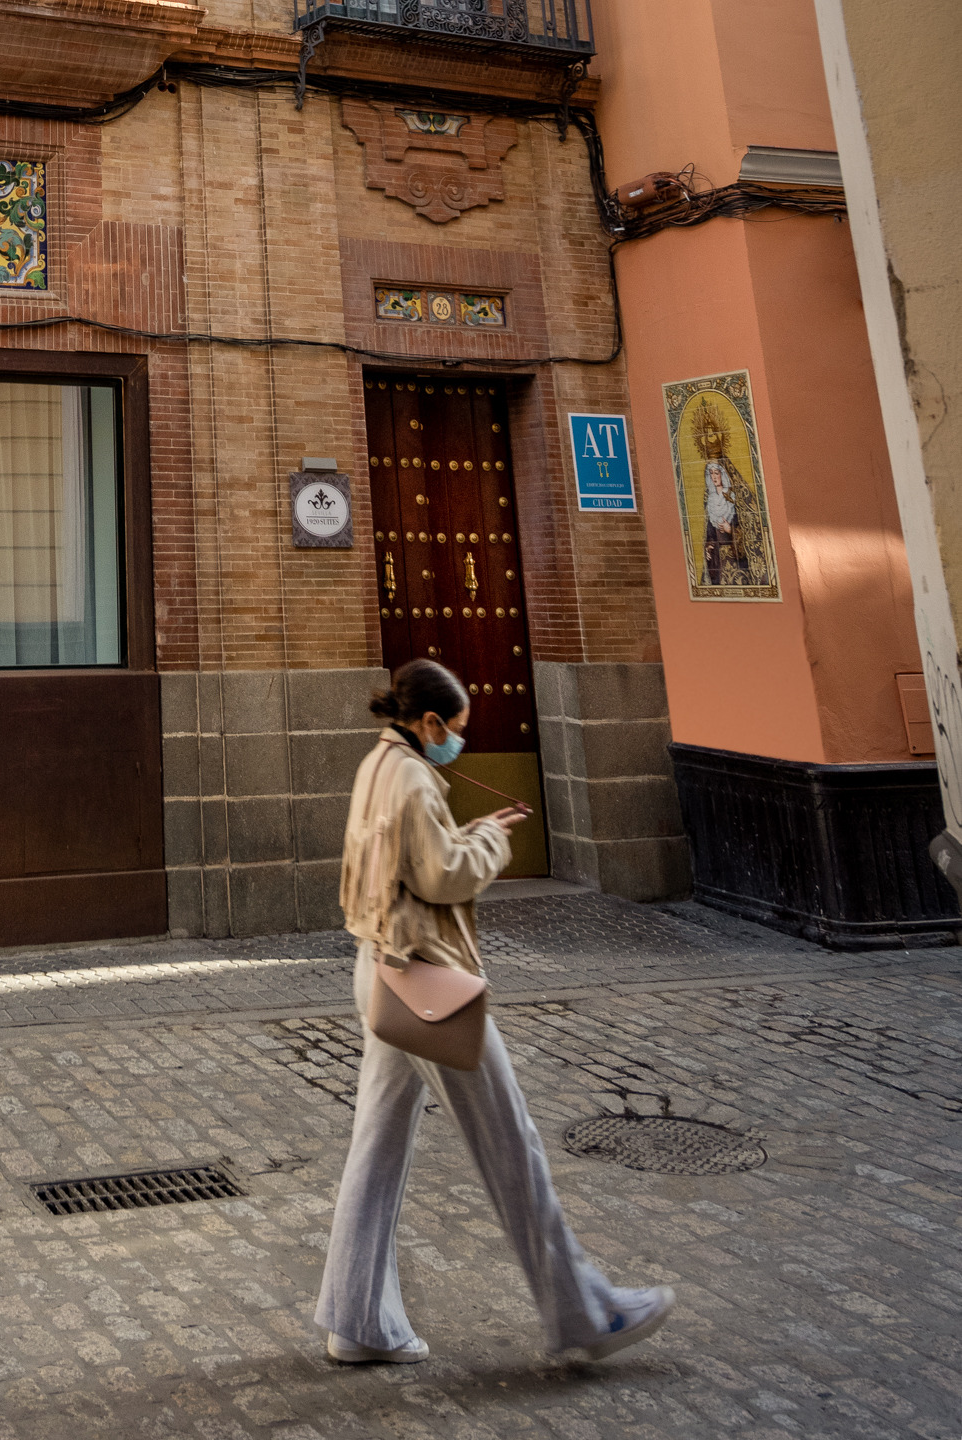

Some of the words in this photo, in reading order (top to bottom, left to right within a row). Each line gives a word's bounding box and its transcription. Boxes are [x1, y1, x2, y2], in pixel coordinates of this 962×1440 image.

[436, 302, 448, 316] 28
[582, 423, 619, 459] AT
[592, 499, 623, 508] CIUDAD
